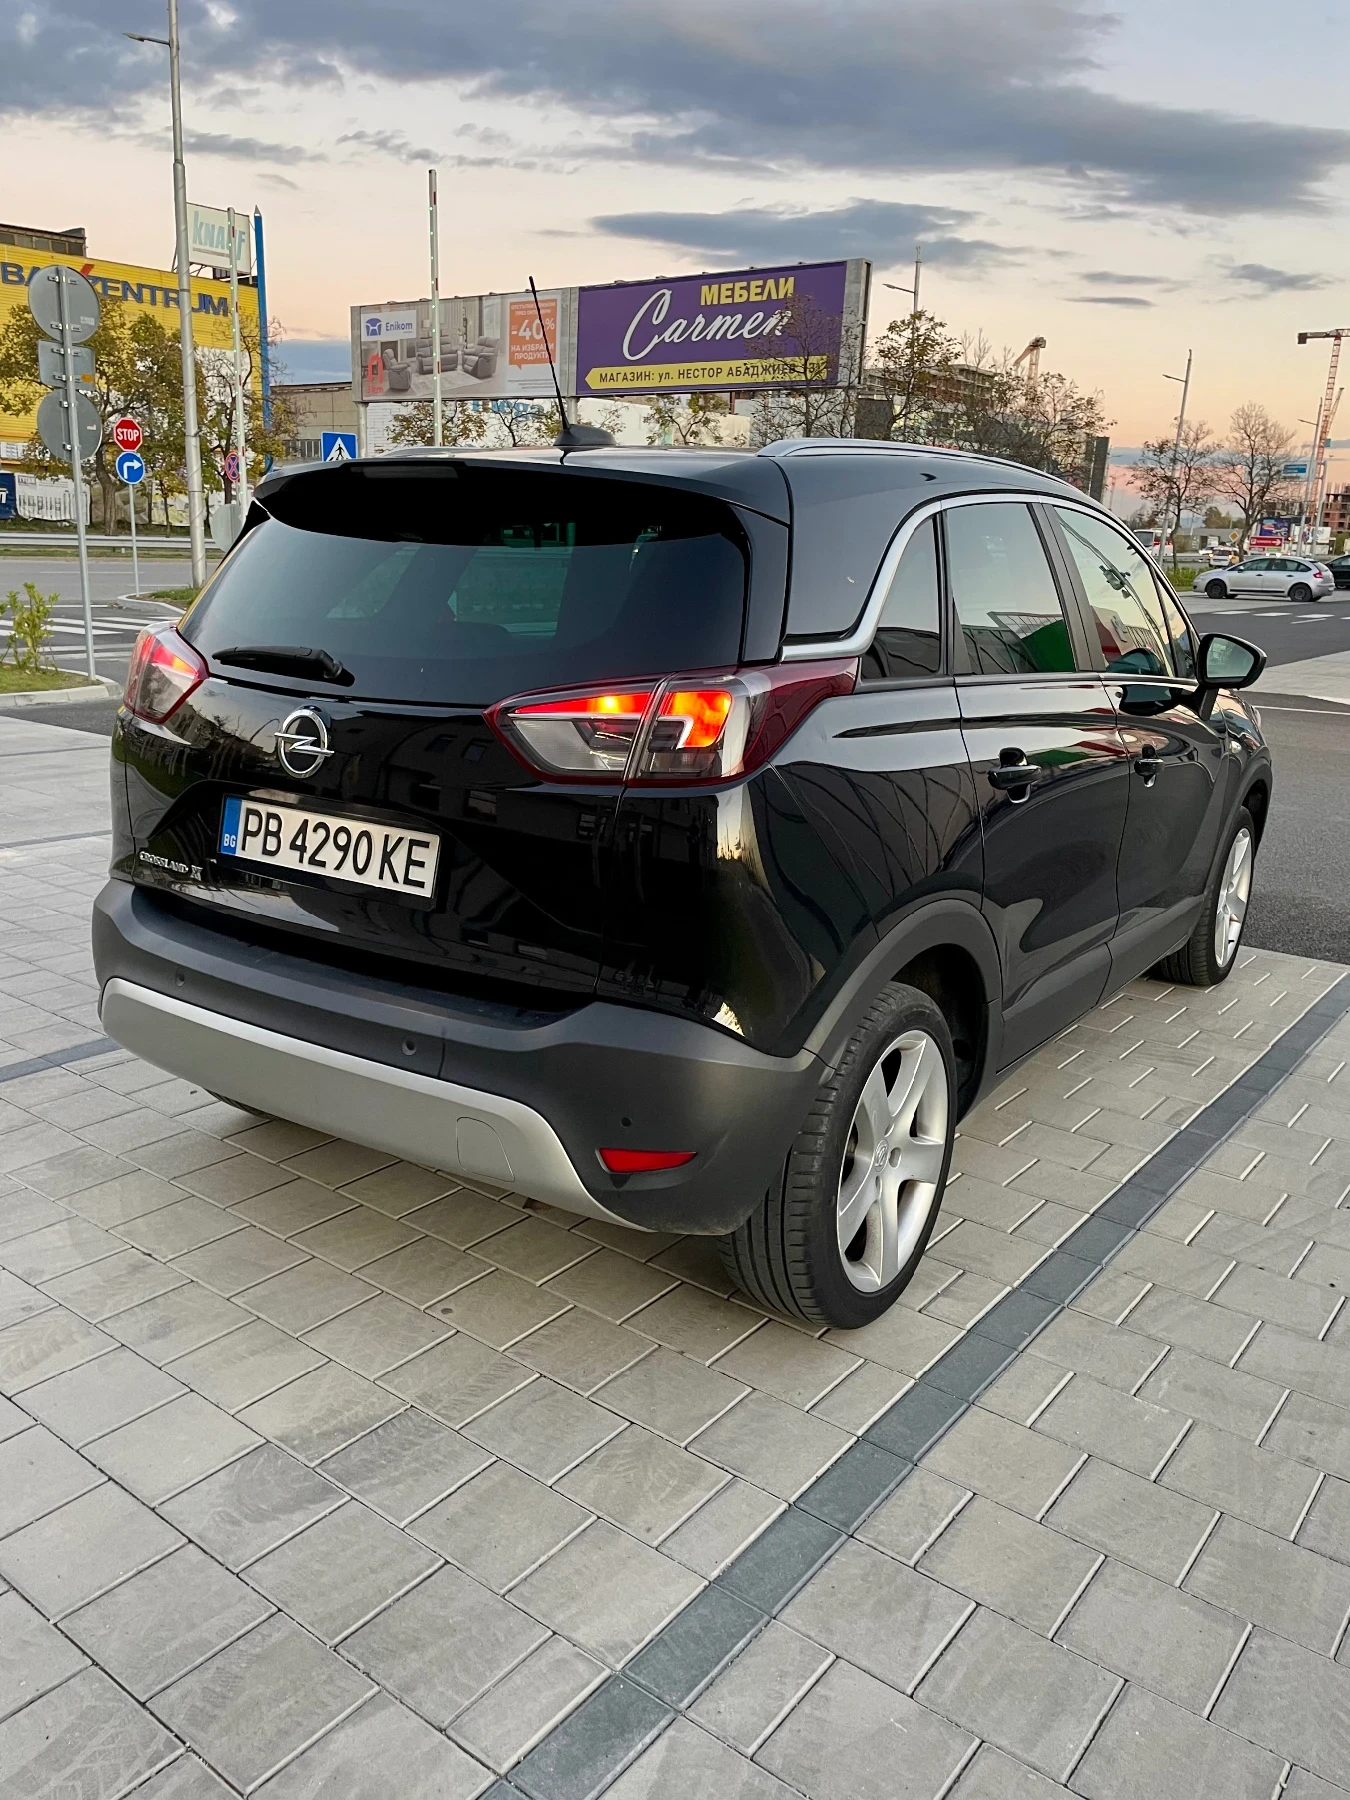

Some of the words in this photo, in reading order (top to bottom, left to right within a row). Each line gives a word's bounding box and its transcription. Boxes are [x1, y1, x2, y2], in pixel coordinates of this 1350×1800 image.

[193, 211, 246, 260] KNAF
[700, 277, 795, 305] МЕБЕЛИ
[385, 321, 413, 331] Enikom
[622, 289, 792, 361] Carmen
[511, 344, 520, 352] НА
[599, 370, 655, 383] МАГАЗИН:
[658, 372, 673, 383] ул.
[678, 366, 723, 379] НЕСТОР
[117, 428, 139, 441] STOP
[223, 833, 237, 848] BG
[241, 807, 283, 857] PB
[289, 818, 373, 876] 4290
[378, 833, 431, 889] KE
[139, 850, 189, 873] CROSSLAND
[189, 864, 204, 881] X
